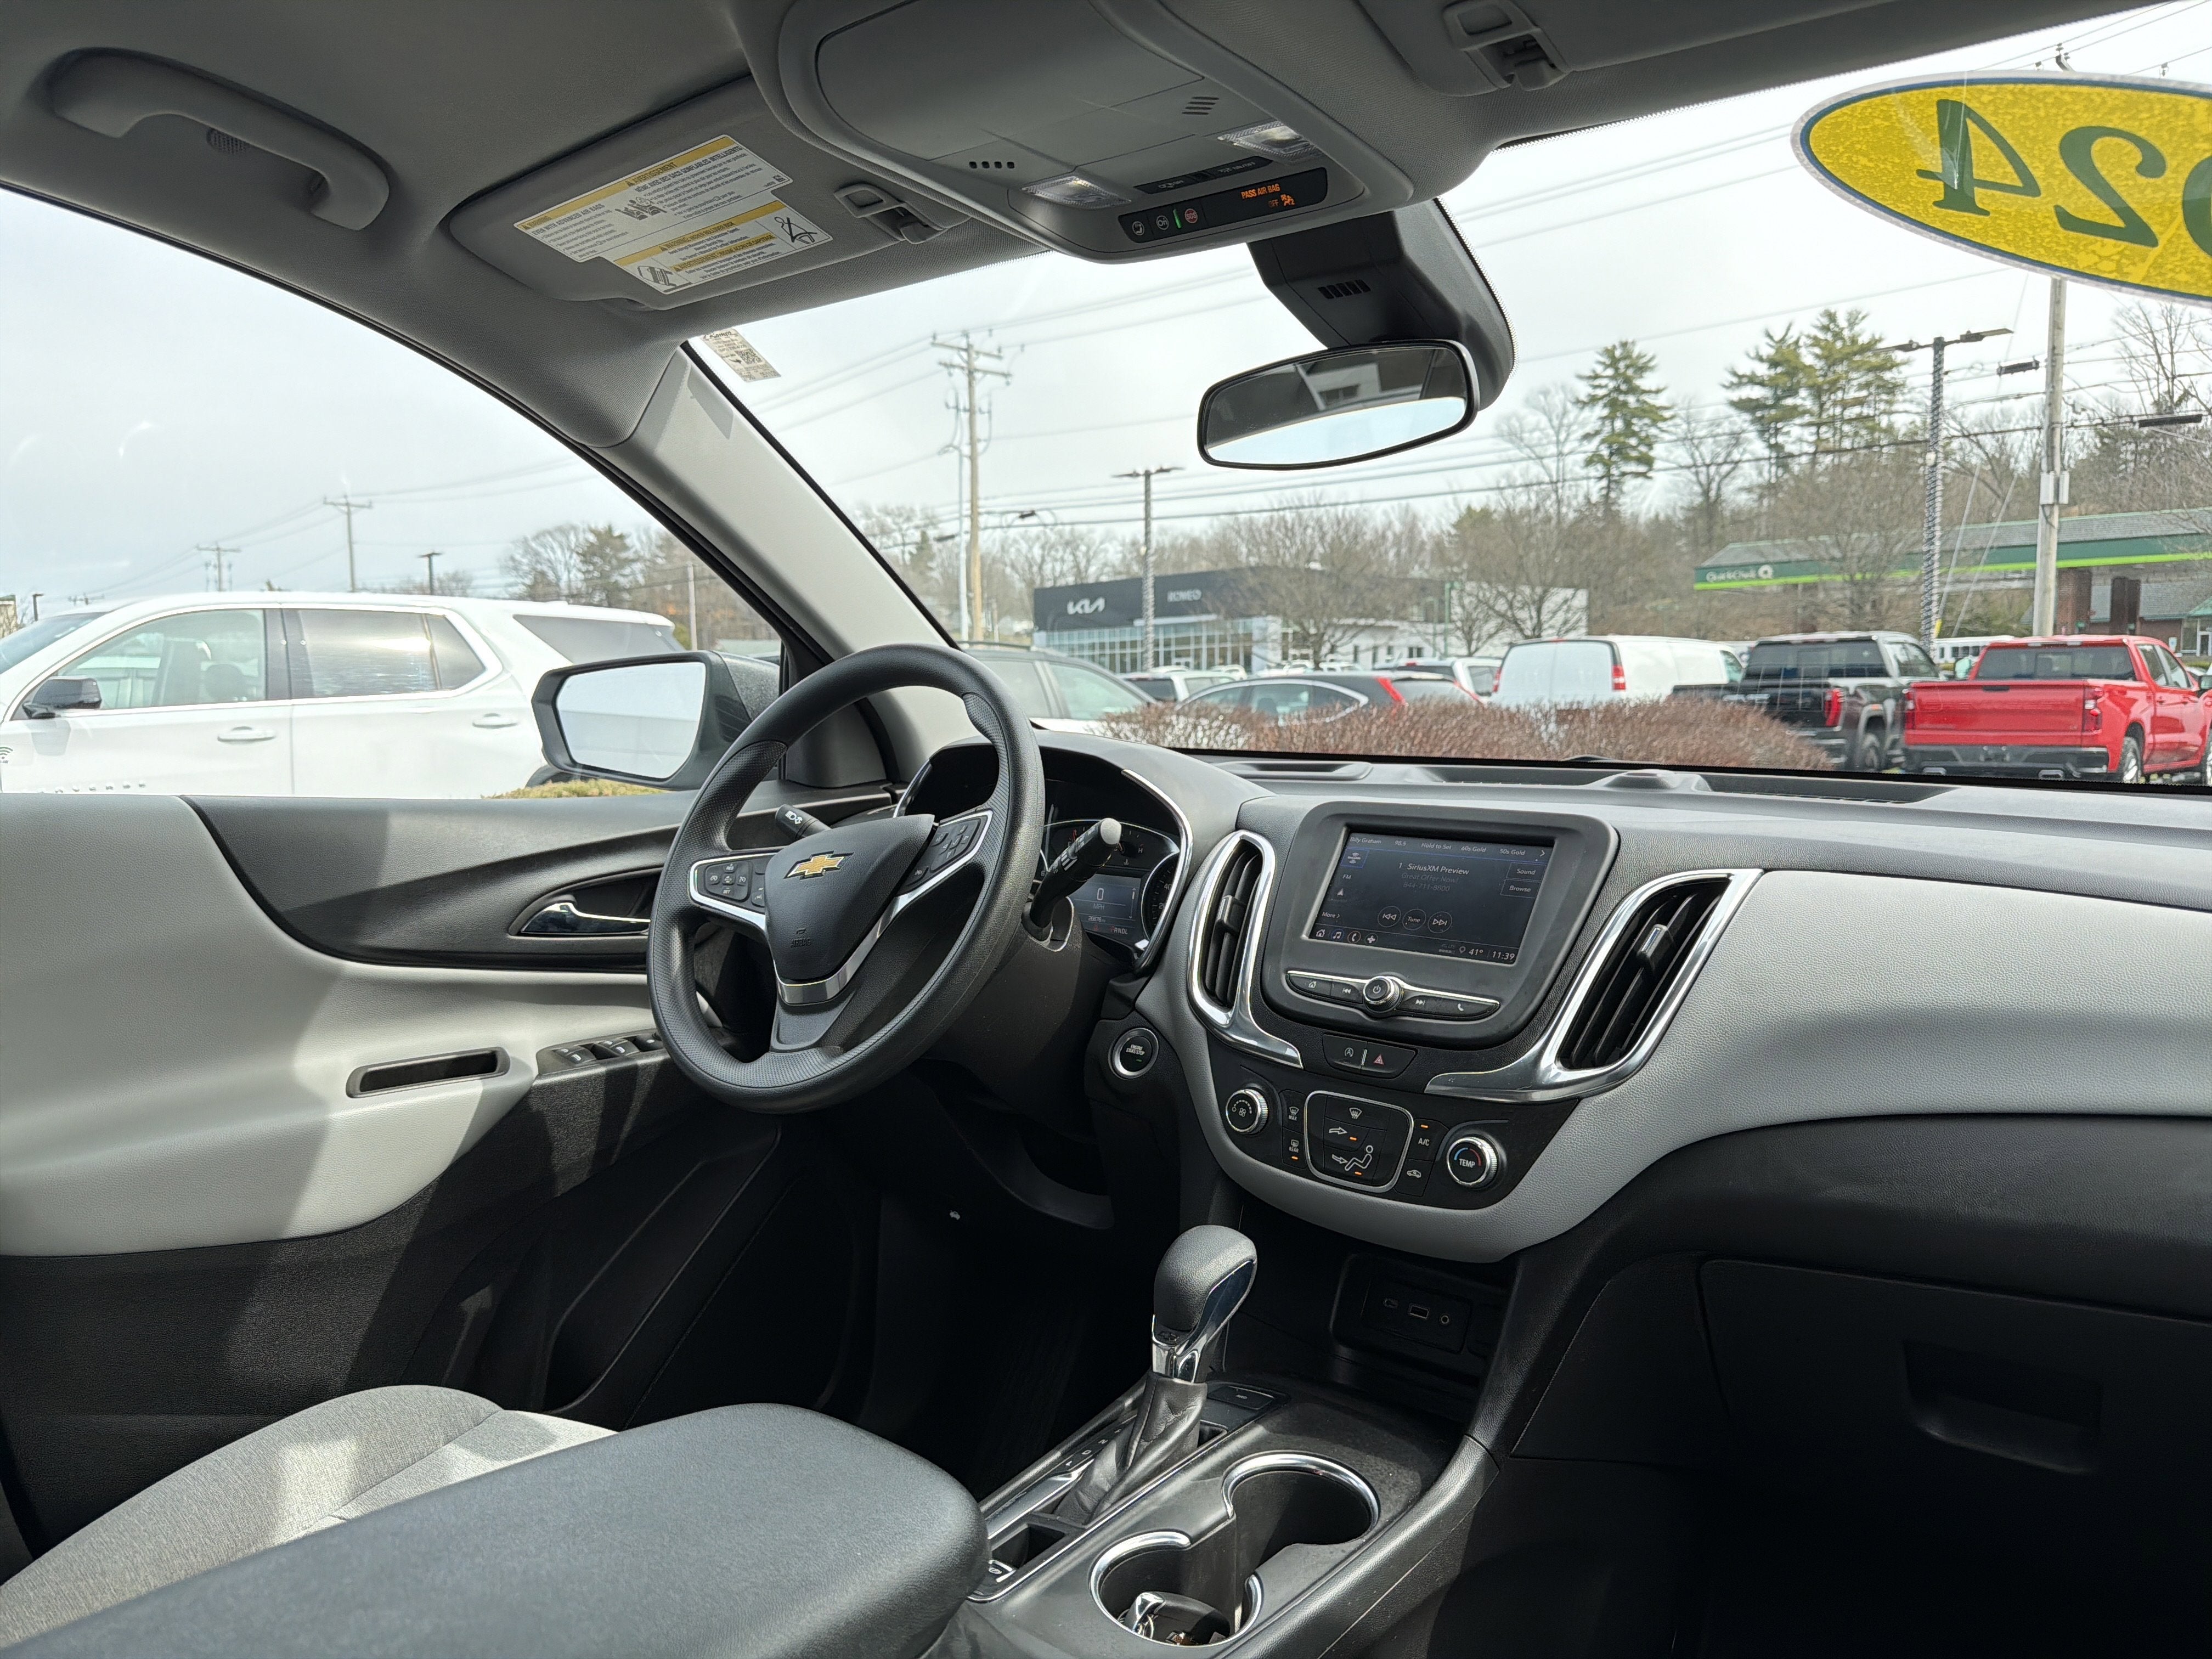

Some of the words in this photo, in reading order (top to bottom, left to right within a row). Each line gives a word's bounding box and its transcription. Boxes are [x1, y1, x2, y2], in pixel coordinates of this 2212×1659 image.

[1241, 188, 1256, 199] PASS
[1257, 185, 1267, 196] AIR
[1268, 183, 1280, 193] BAG
[1268, 199, 1279, 208] OFF
[1186, 212, 1197, 220] SOS
[1407, 863, 1439, 872] SiriusXM
[1440, 865, 1470, 875] Preview
[1097, 888, 1104, 901] 0
[1492, 951, 1515, 960] 11:39
[1418, 1137, 1430, 1147] A/C
[1459, 1158, 1476, 1169] TEMP
